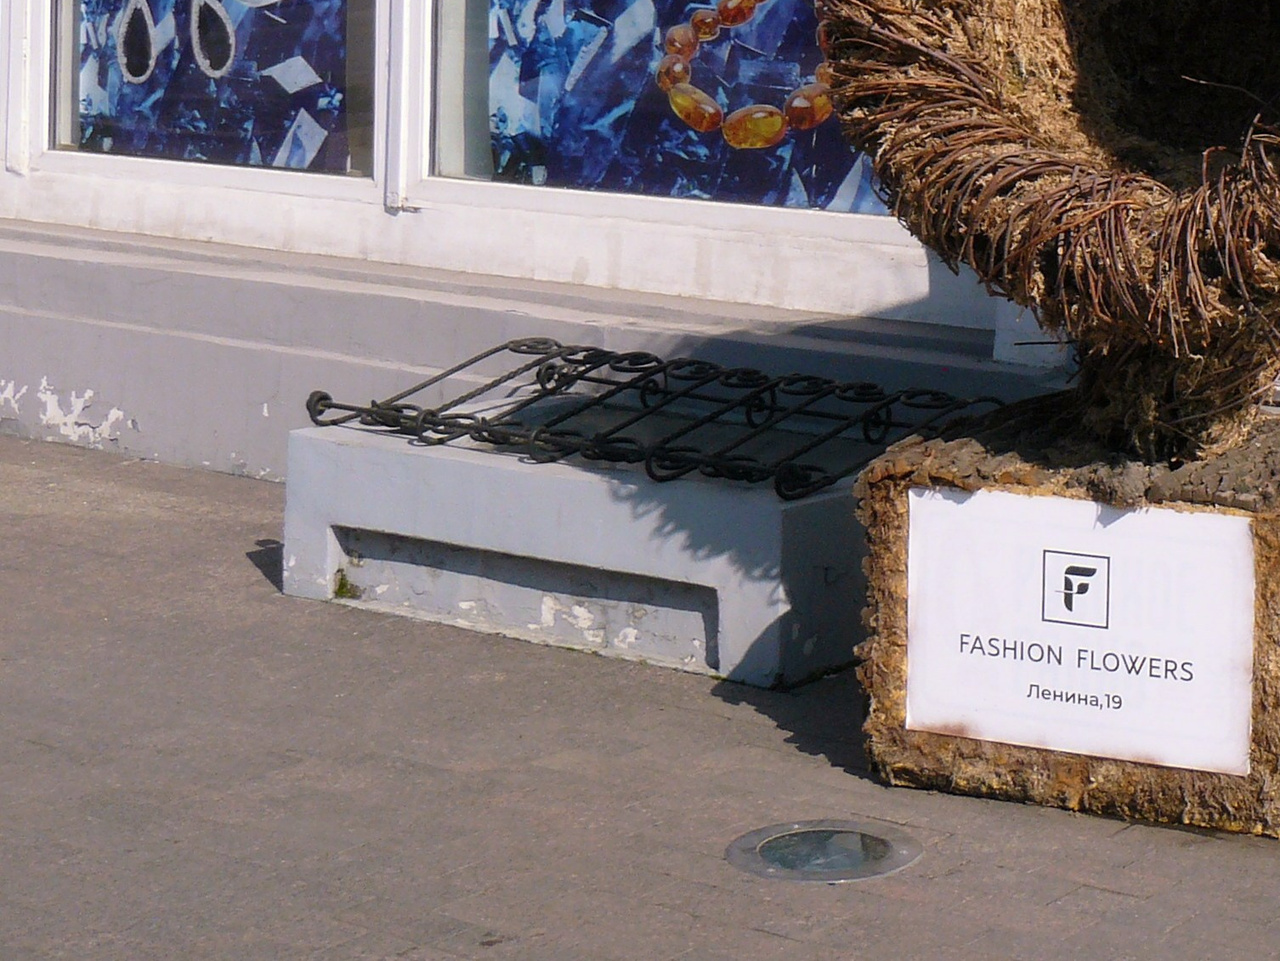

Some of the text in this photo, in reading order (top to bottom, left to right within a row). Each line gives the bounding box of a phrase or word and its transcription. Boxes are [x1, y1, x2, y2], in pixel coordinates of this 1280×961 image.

[959, 633, 1195, 683] FASHION FLOWERS
[1027, 684, 1123, 710] Ленина,19
